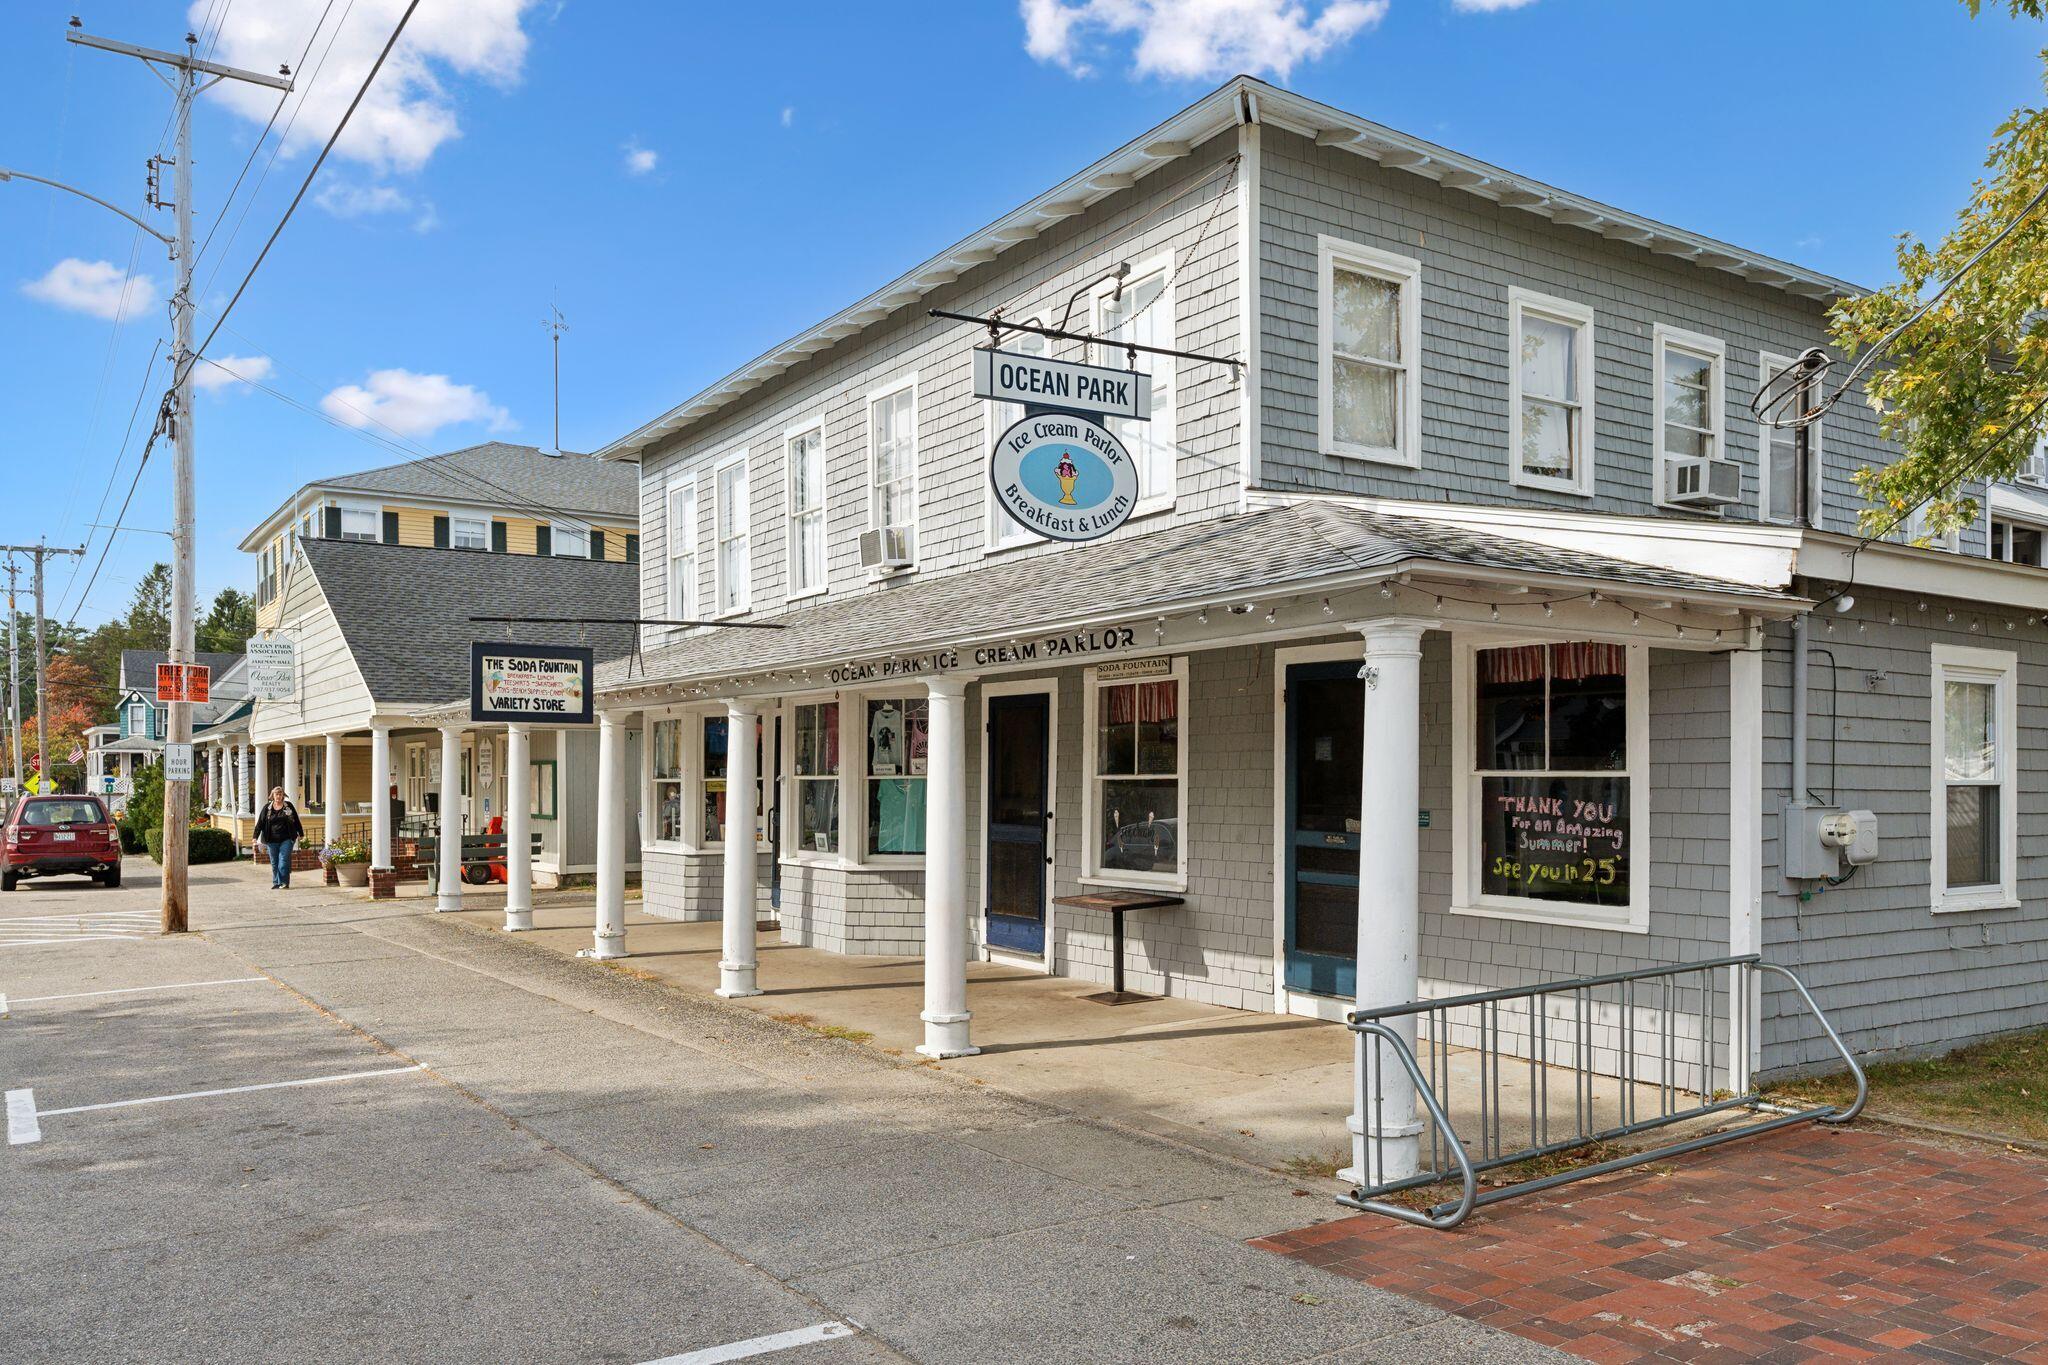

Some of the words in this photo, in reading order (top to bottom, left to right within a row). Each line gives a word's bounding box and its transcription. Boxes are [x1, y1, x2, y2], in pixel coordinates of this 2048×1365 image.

[1000, 363, 1069, 397] OCEAN
[1077, 375, 1129, 406] PARK
[1008, 432, 1032, 454] Ice
[1034, 422, 1078, 438] Cream
[1084, 427, 1123, 465] Parlor
[1005, 483, 1075, 532] Breakfast
[1079, 517, 1090, 532] &
[1091, 495, 1129, 530] Lunch
[485, 658, 504, 670] THE
[508, 659, 537, 673] SODA
[539, 660, 578, 674] FOUNTAIN
[831, 664, 875, 683] OCEAN
[883, 658, 922, 676] PARK
[933, 652, 958, 669] ICE
[975, 643, 1037, 664] CREAM
[1046, 628, 1135, 656] PARLOR
[1098, 664, 1121, 673] SODA
[1122, 659, 1168, 670] FOUNTAIN
[489, 696, 531, 710] VARIETY
[533, 698, 566, 711] STORE
[1498, 796, 1563, 817] THANK
[1573, 799, 1614, 823] YOU
[1512, 816, 1531, 829] For
[1534, 819, 1552, 832] an
[1520, 831, 1588, 853] Summer!
[1493, 857, 1521, 879] See
[1527, 863, 1560, 885] you
[1565, 864, 1578, 880] in
